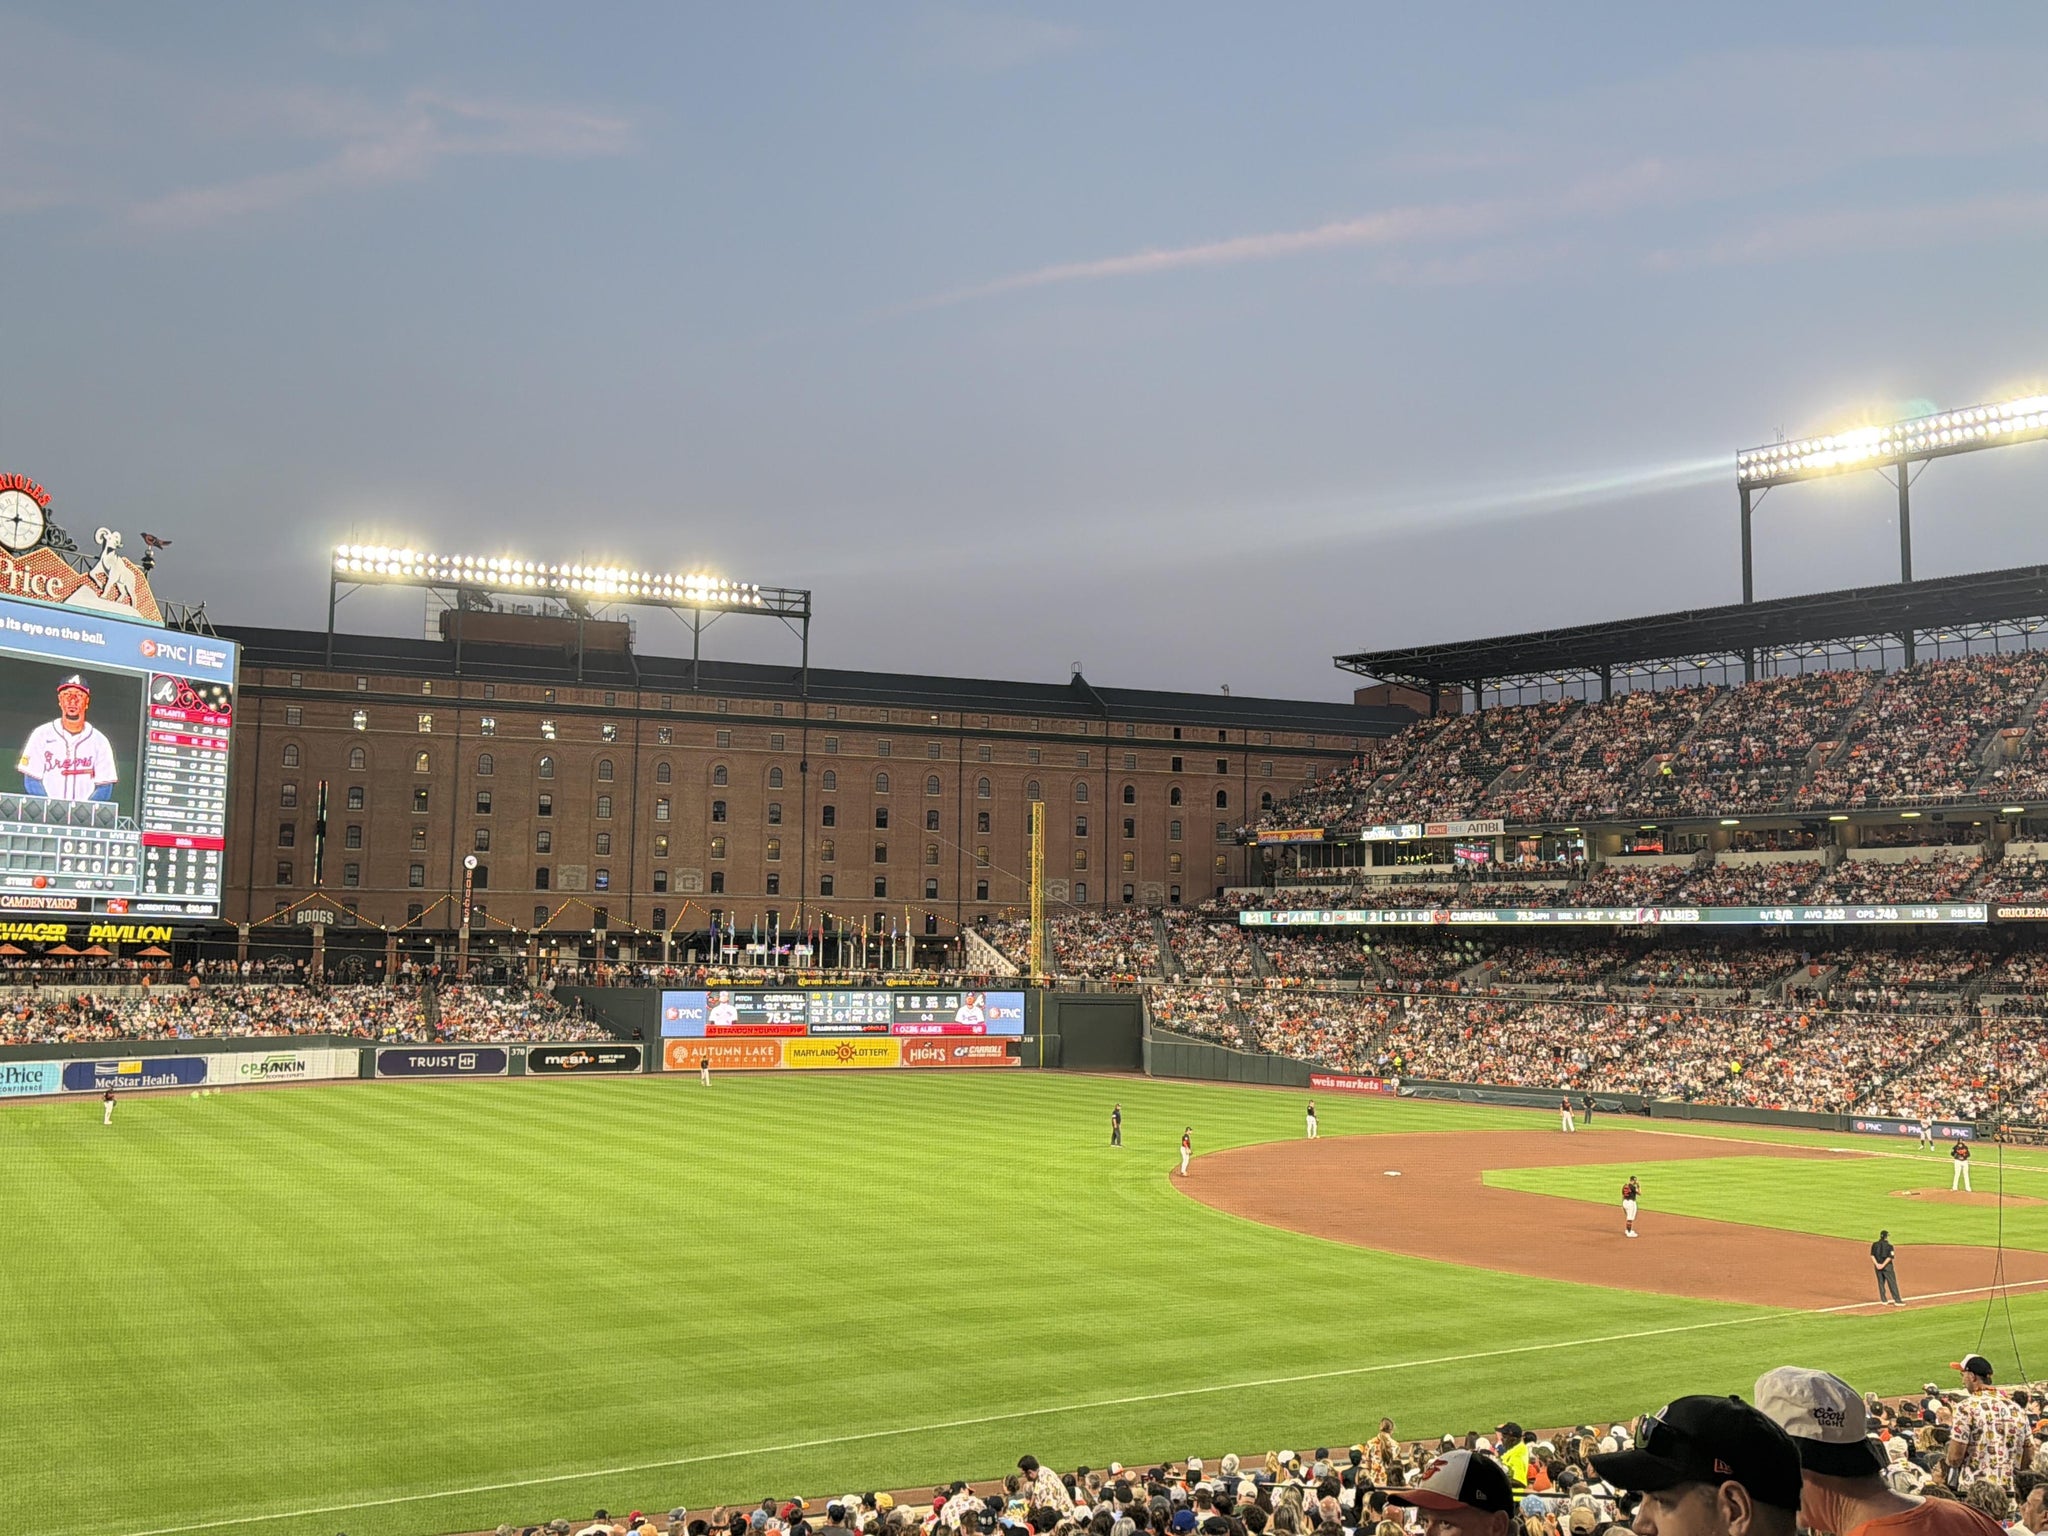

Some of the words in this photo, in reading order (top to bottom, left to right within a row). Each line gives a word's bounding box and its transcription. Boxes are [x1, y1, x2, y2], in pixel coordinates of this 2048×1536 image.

[6, 617, 21, 631] its
[44, 626, 60, 637] on
[61, 627, 80, 640] the
[156, 643, 187, 661] PNC
[1467, 822, 1498, 833] AMBI
[64, 841, 73, 853] 0
[79, 842, 87, 854] 3
[94, 844, 100, 854] 1
[112, 844, 120, 856] 3
[126, 845, 134, 857] 2
[62, 859, 71, 871] 2
[77, 861, 86, 872] 4
[92, 861, 101, 873] 0
[111, 862, 119, 874] 4
[125, 863, 133, 874] 2
[76, 880, 93, 888] OUT
[1, 896, 45, 908] CAMDEN
[46, 898, 77, 910] YARDS
[297, 910, 334, 924] BOOGS
[1301, 912, 1316, 922] ATL
[1323, 912, 1330, 922] 0
[1369, 912, 1376, 922] 2
[1450, 912, 1498, 921] CURVEBALL
[1660, 910, 1699, 921] ALBIES
[1804, 911, 1822, 919] AVG
[1824, 909, 1845, 920] .262
[1856, 910, 1874, 918] OPS
[1876, 908, 1898, 919] .746
[1912, 909, 1925, 918] HR
[1951, 909, 1966, 918] RBI
[1997, 908, 2034, 918] ORIOLE
[0, 923, 67, 942] WAGER
[88, 925, 173, 943] PAVILION
[706, 978, 731, 986] Corona
[798, 978, 822, 986] Corona
[886, 978, 910, 986] Corona
[678, 1009, 702, 1018] PNC
[1000, 1009, 1020, 1018] PNC
[691, 1047, 741, 1056] AUTUMN
[746, 1047, 774, 1055] LAKE
[910, 1048, 946, 1062] HIGH'S
[408, 1056, 456, 1067] TRUIST
[241, 1063, 258, 1074] CP
[260, 1061, 305, 1073] RANKIN
[5, 1067, 43, 1084] Price
[95, 1076, 140, 1088] MedStar
[142, 1074, 178, 1086] Health
[1312, 1078, 1335, 1087] weis
[1336, 1079, 1379, 1090] markets
[1866, 1123, 1882, 1131] PNC
[1951, 1129, 1968, 1137] PNC
[1814, 1408, 1845, 1420] Coors
[1818, 1419, 1844, 1428] LIGHT
